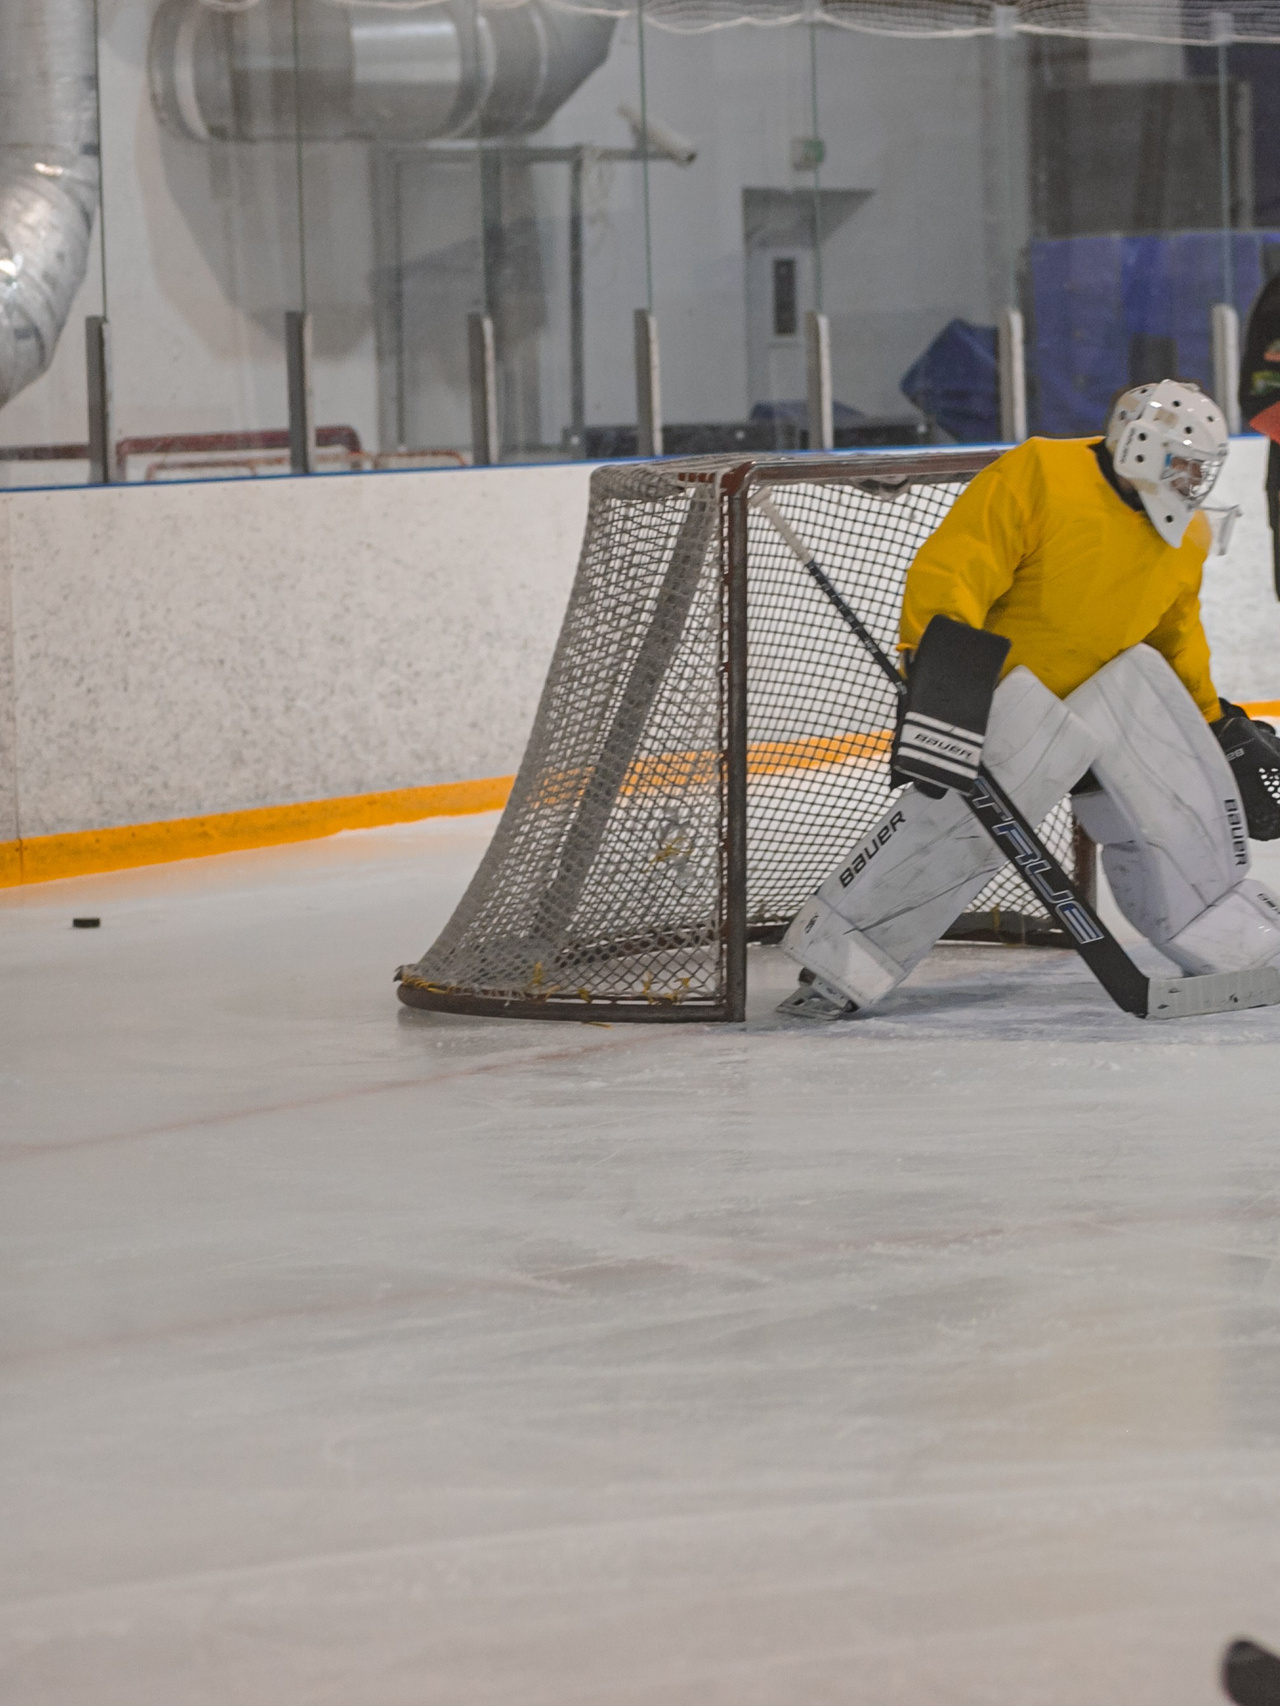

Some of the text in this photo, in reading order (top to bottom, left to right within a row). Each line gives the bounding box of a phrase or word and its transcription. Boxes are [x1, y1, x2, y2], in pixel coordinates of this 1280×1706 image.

[914, 733, 973, 760] BAUER
[838, 810, 907, 889] BAUER
[972, 775, 1105, 945] TRUE
[1224, 799, 1247, 867] BAUER
